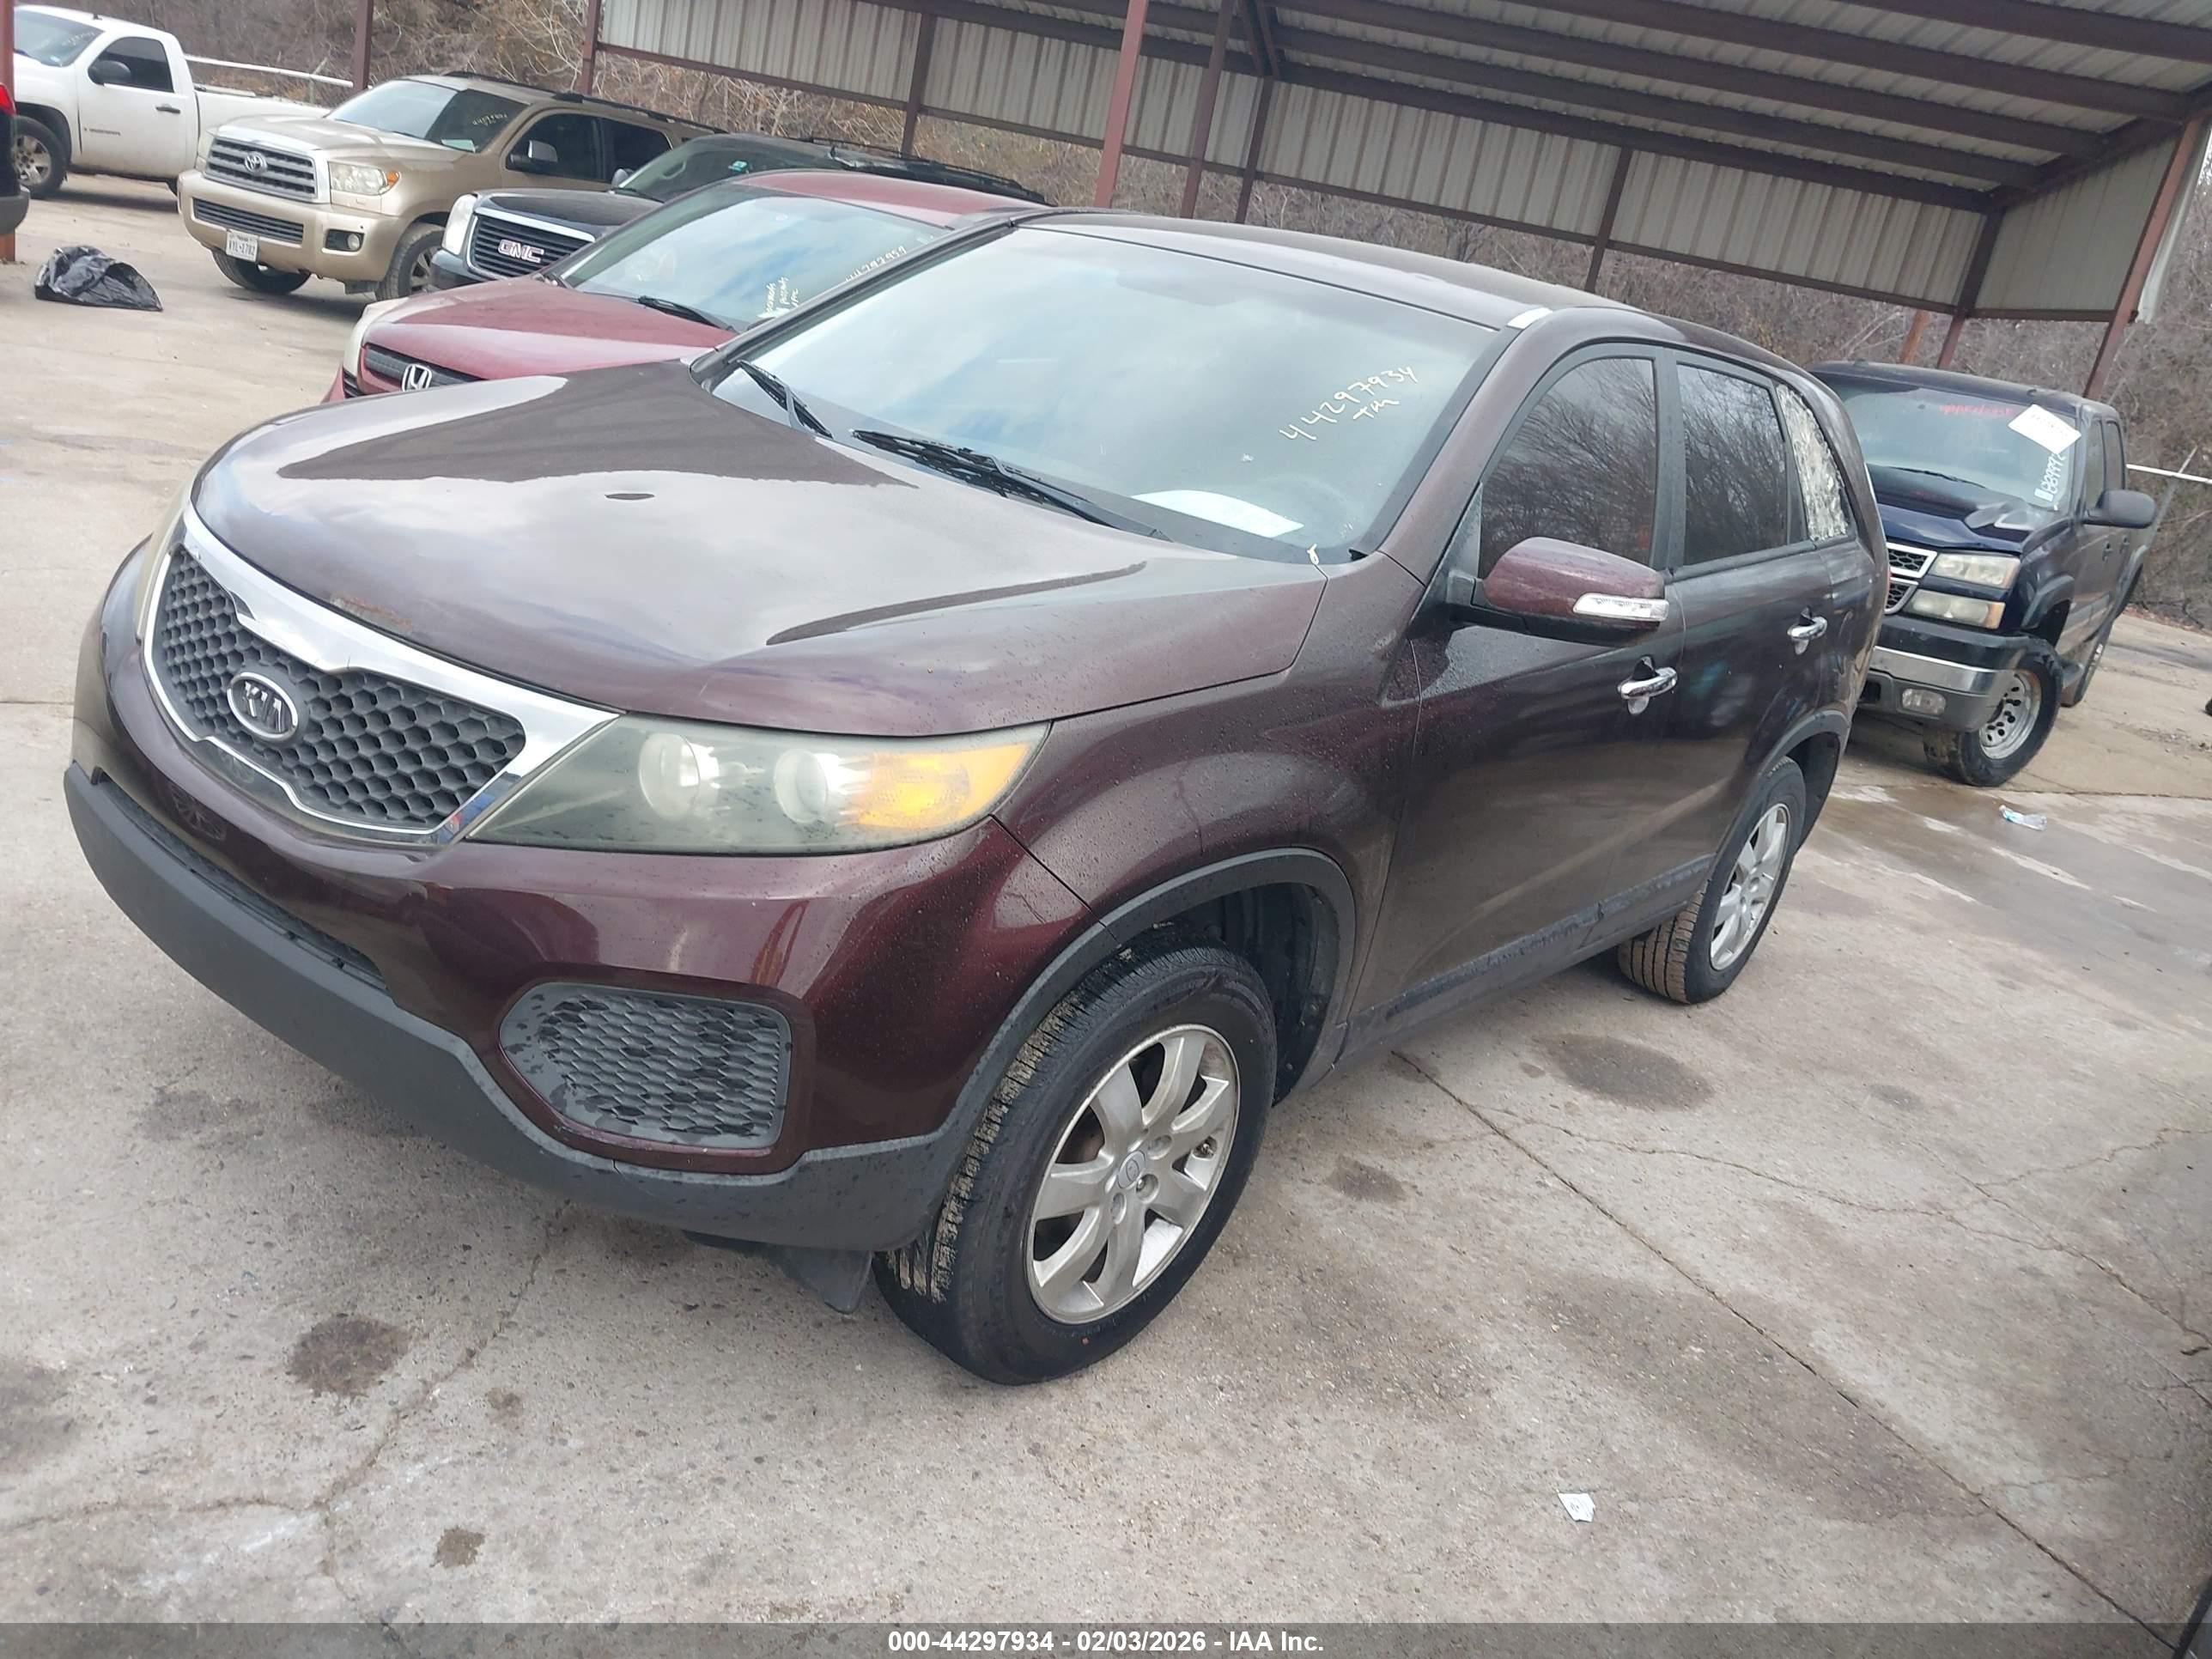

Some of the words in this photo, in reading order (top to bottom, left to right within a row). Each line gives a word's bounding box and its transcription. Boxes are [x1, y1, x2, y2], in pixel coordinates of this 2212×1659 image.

[498, 239, 544, 264] GMC
[1278, 366, 1419, 441] 44297934
[241, 680, 287, 733] KIA
